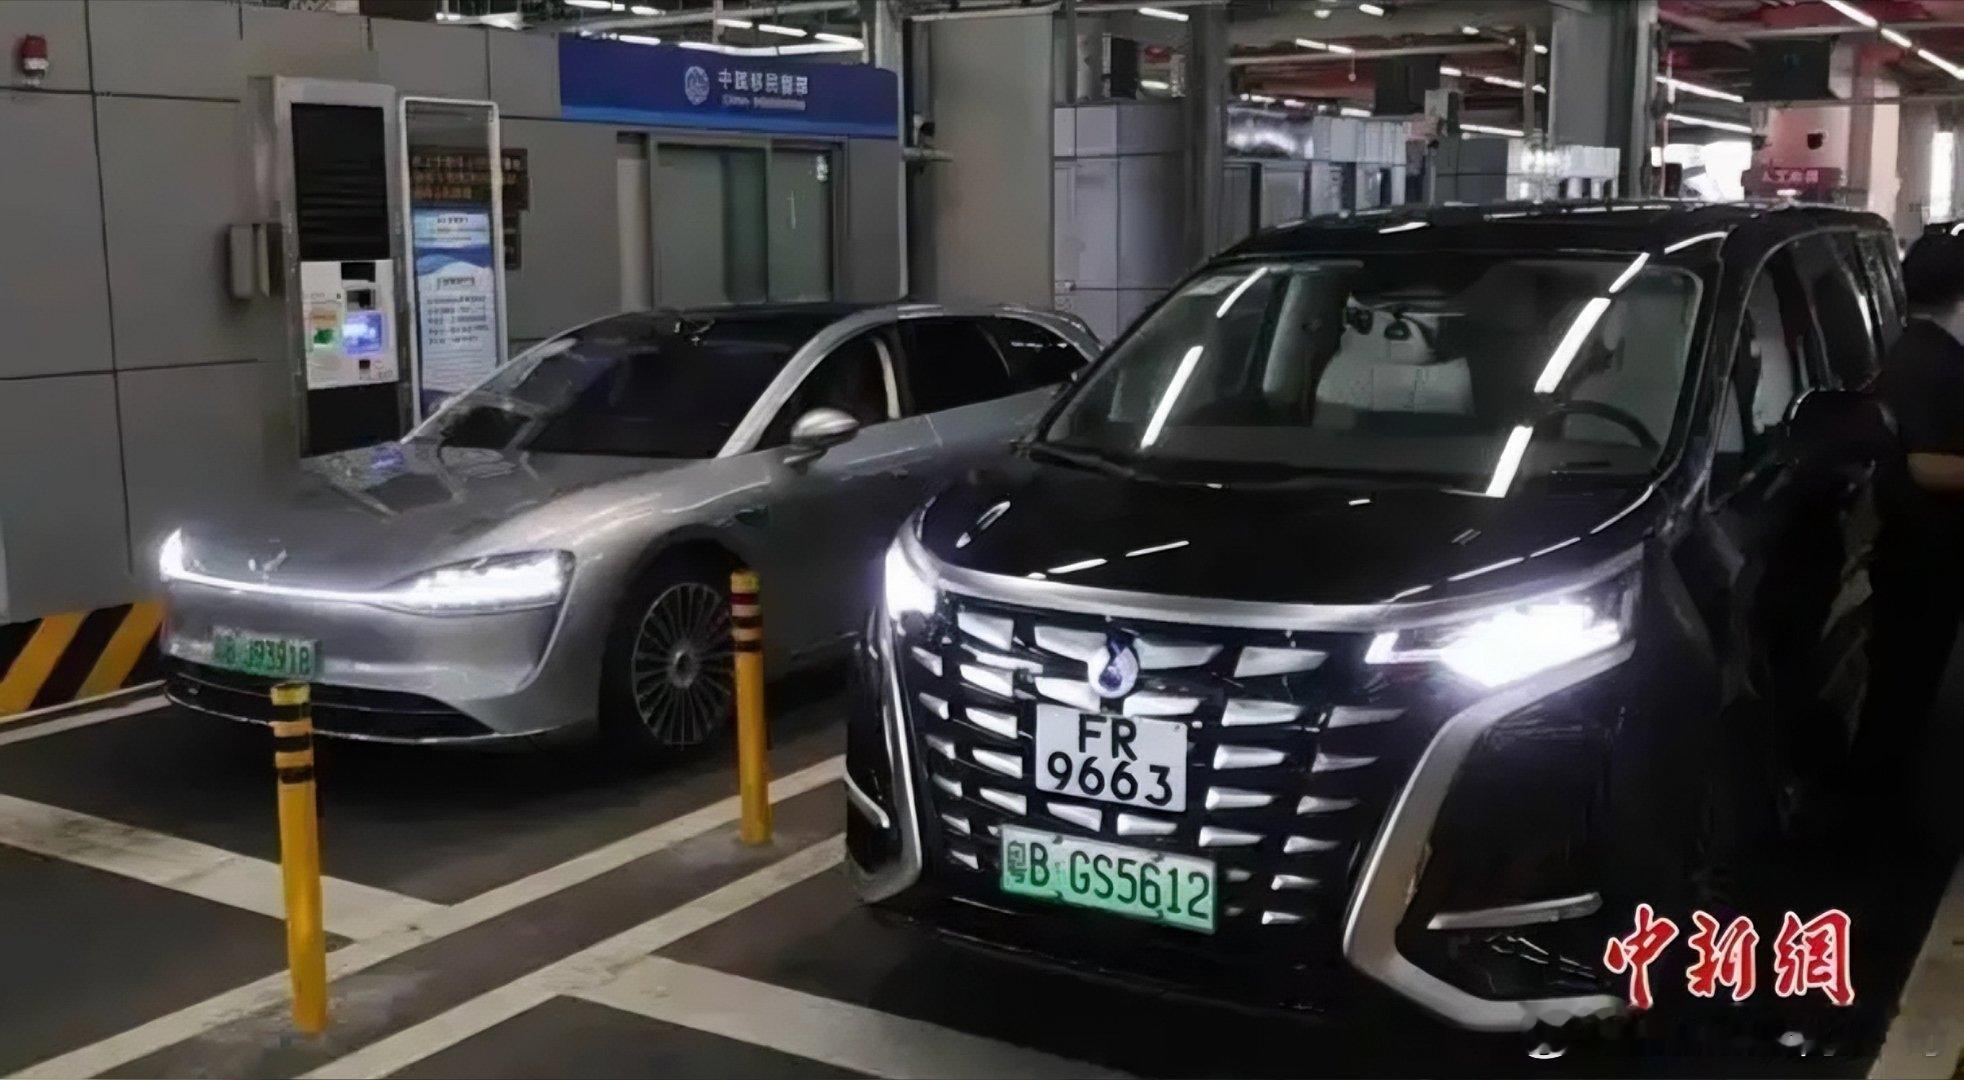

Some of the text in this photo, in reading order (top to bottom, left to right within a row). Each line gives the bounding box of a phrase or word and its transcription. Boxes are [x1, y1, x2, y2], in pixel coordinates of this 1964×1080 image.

[1079, 713, 1137, 761] FR
[1047, 751, 1174, 806] 9663
[1070, 850, 1209, 919] GS5612
